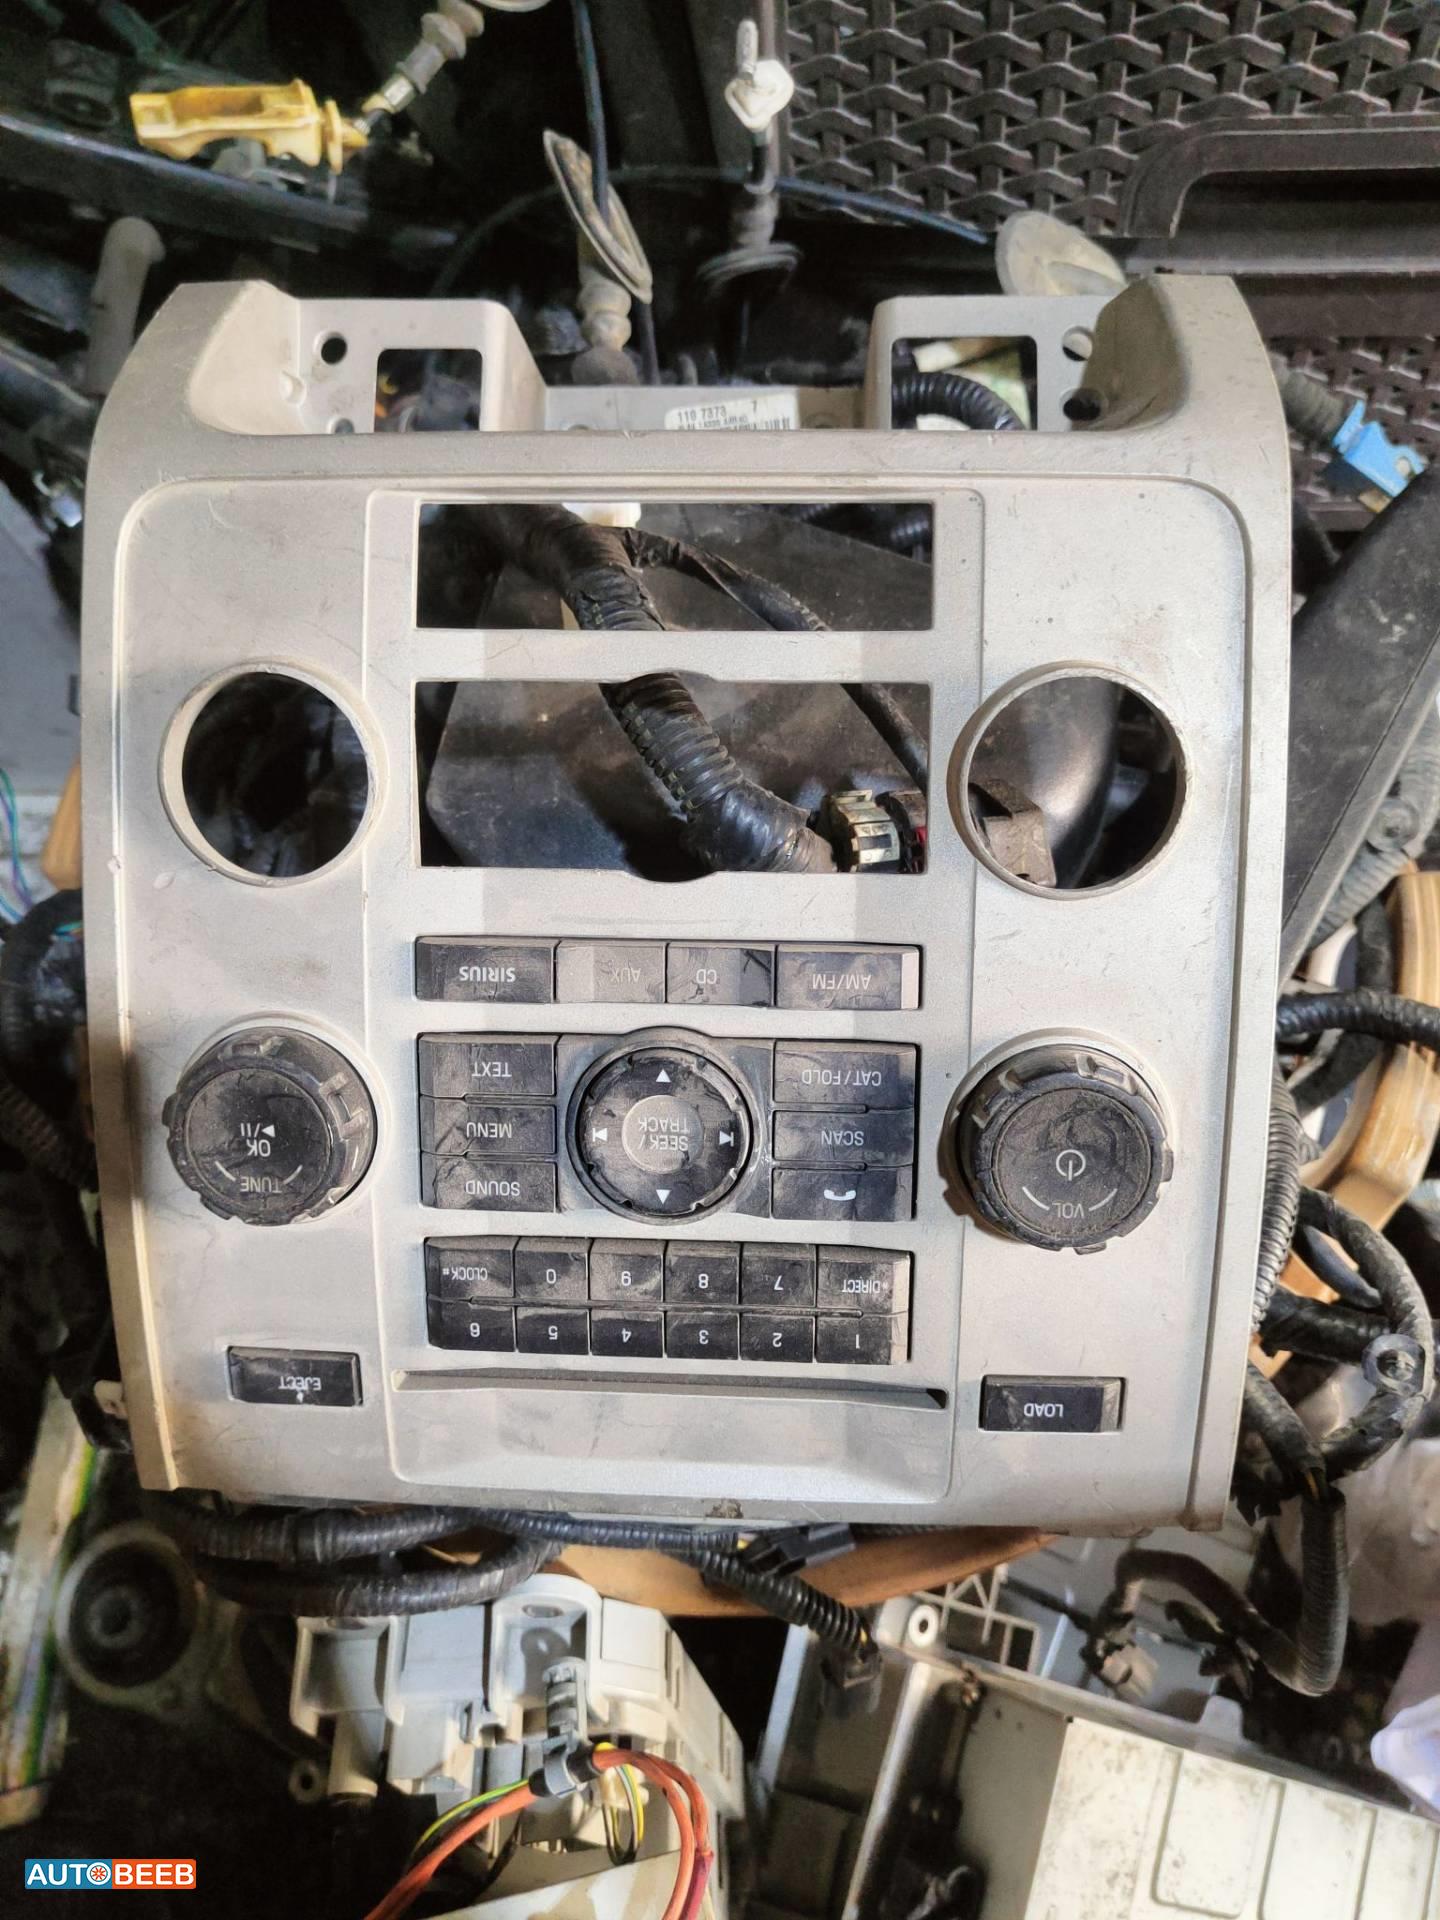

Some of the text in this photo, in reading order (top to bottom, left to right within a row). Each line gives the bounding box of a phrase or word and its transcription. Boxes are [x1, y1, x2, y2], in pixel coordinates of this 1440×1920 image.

[459, 965, 516, 983] SIRIUS
[611, 966, 641, 982] AUX
[696, 968, 717, 984] CD
[812, 973, 871, 990] AM/FM
[471, 1061, 512, 1078] TEXT
[466, 1121, 512, 1139] MENU
[638, 1116, 690, 1133] TRACK
[821, 1130, 864, 1147] SCAN
[246, 1138, 271, 1157] OK
[239, 1175, 282, 1194] TUNE
[465, 1180, 520, 1197] SOUND
[1052, 1202, 1085, 1220] VOL
[546, 1268, 557, 1284] 0
[621, 1270, 632, 1287] 9
[698, 1273, 709, 1289] 8
[774, 1274, 784, 1291] 7
[469, 1322, 481, 1338] 6
[548, 1325, 558, 1341] 5
[621, 1327, 632, 1343] 4
[698, 1329, 709, 1345] 3
[772, 1332, 783, 1348] 2
[855, 1333, 861, 1349] 1
[278, 1376, 321, 1391] EJECT
[1023, 1402, 1064, 1418] LOAD
